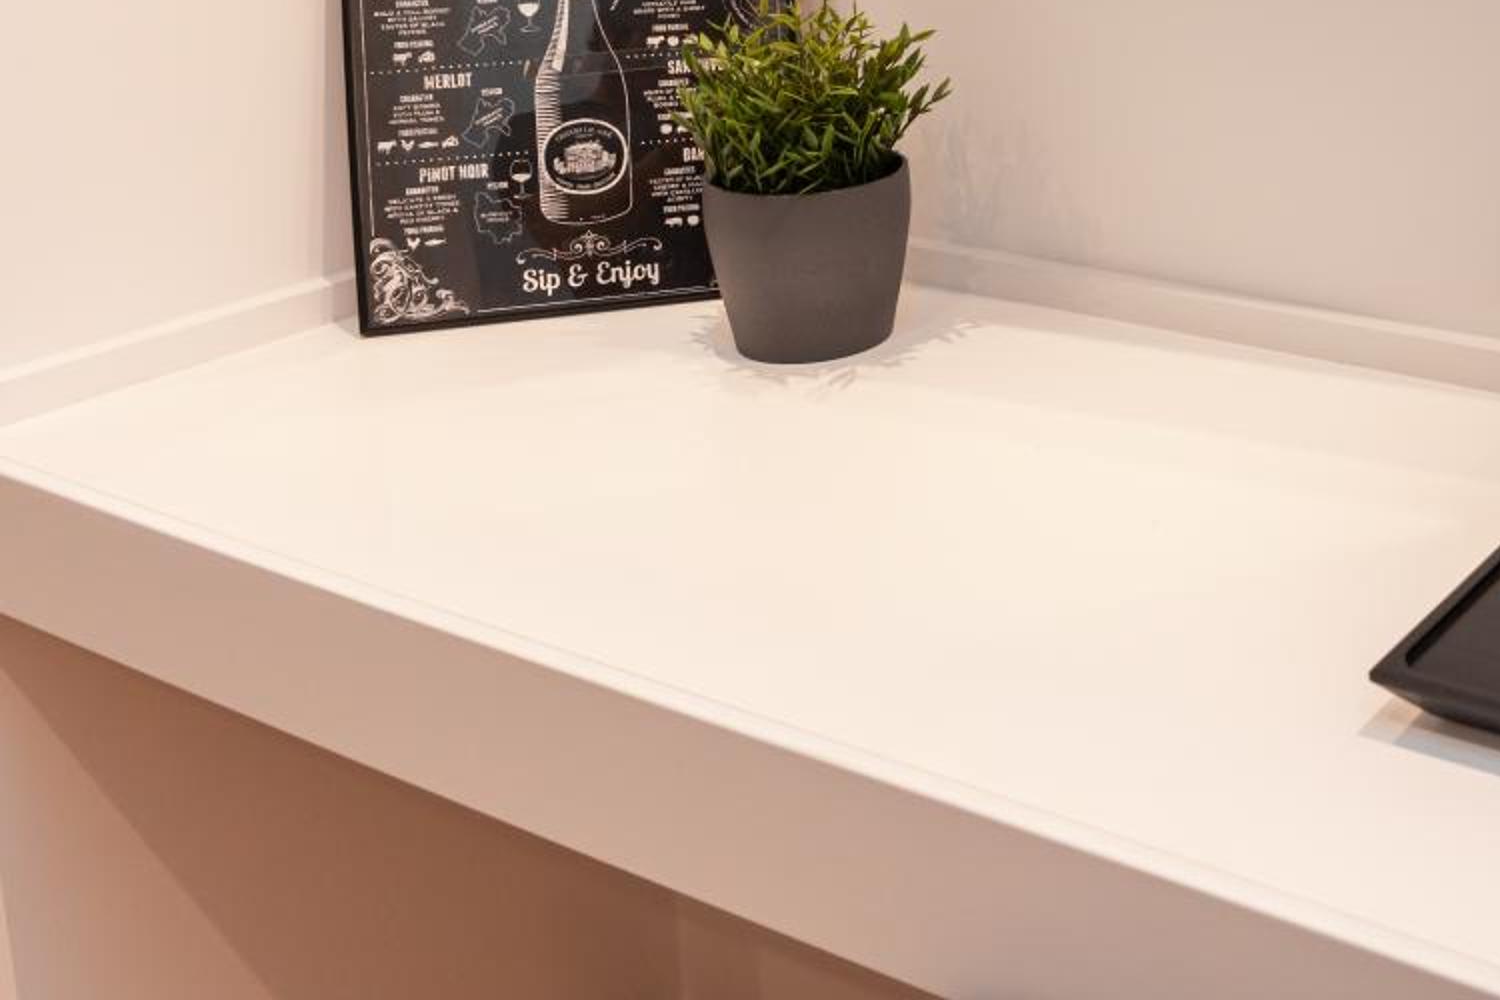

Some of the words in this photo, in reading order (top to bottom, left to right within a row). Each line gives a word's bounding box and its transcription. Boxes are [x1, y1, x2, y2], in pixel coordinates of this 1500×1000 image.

[423, 72, 473, 90] MERLOT
[418, 165, 457, 184] PINOT
[458, 162, 490, 180] NOIR
[522, 268, 562, 297] Sip
[567, 263, 589, 288] &
[595, 259, 661, 290] Enjoy
